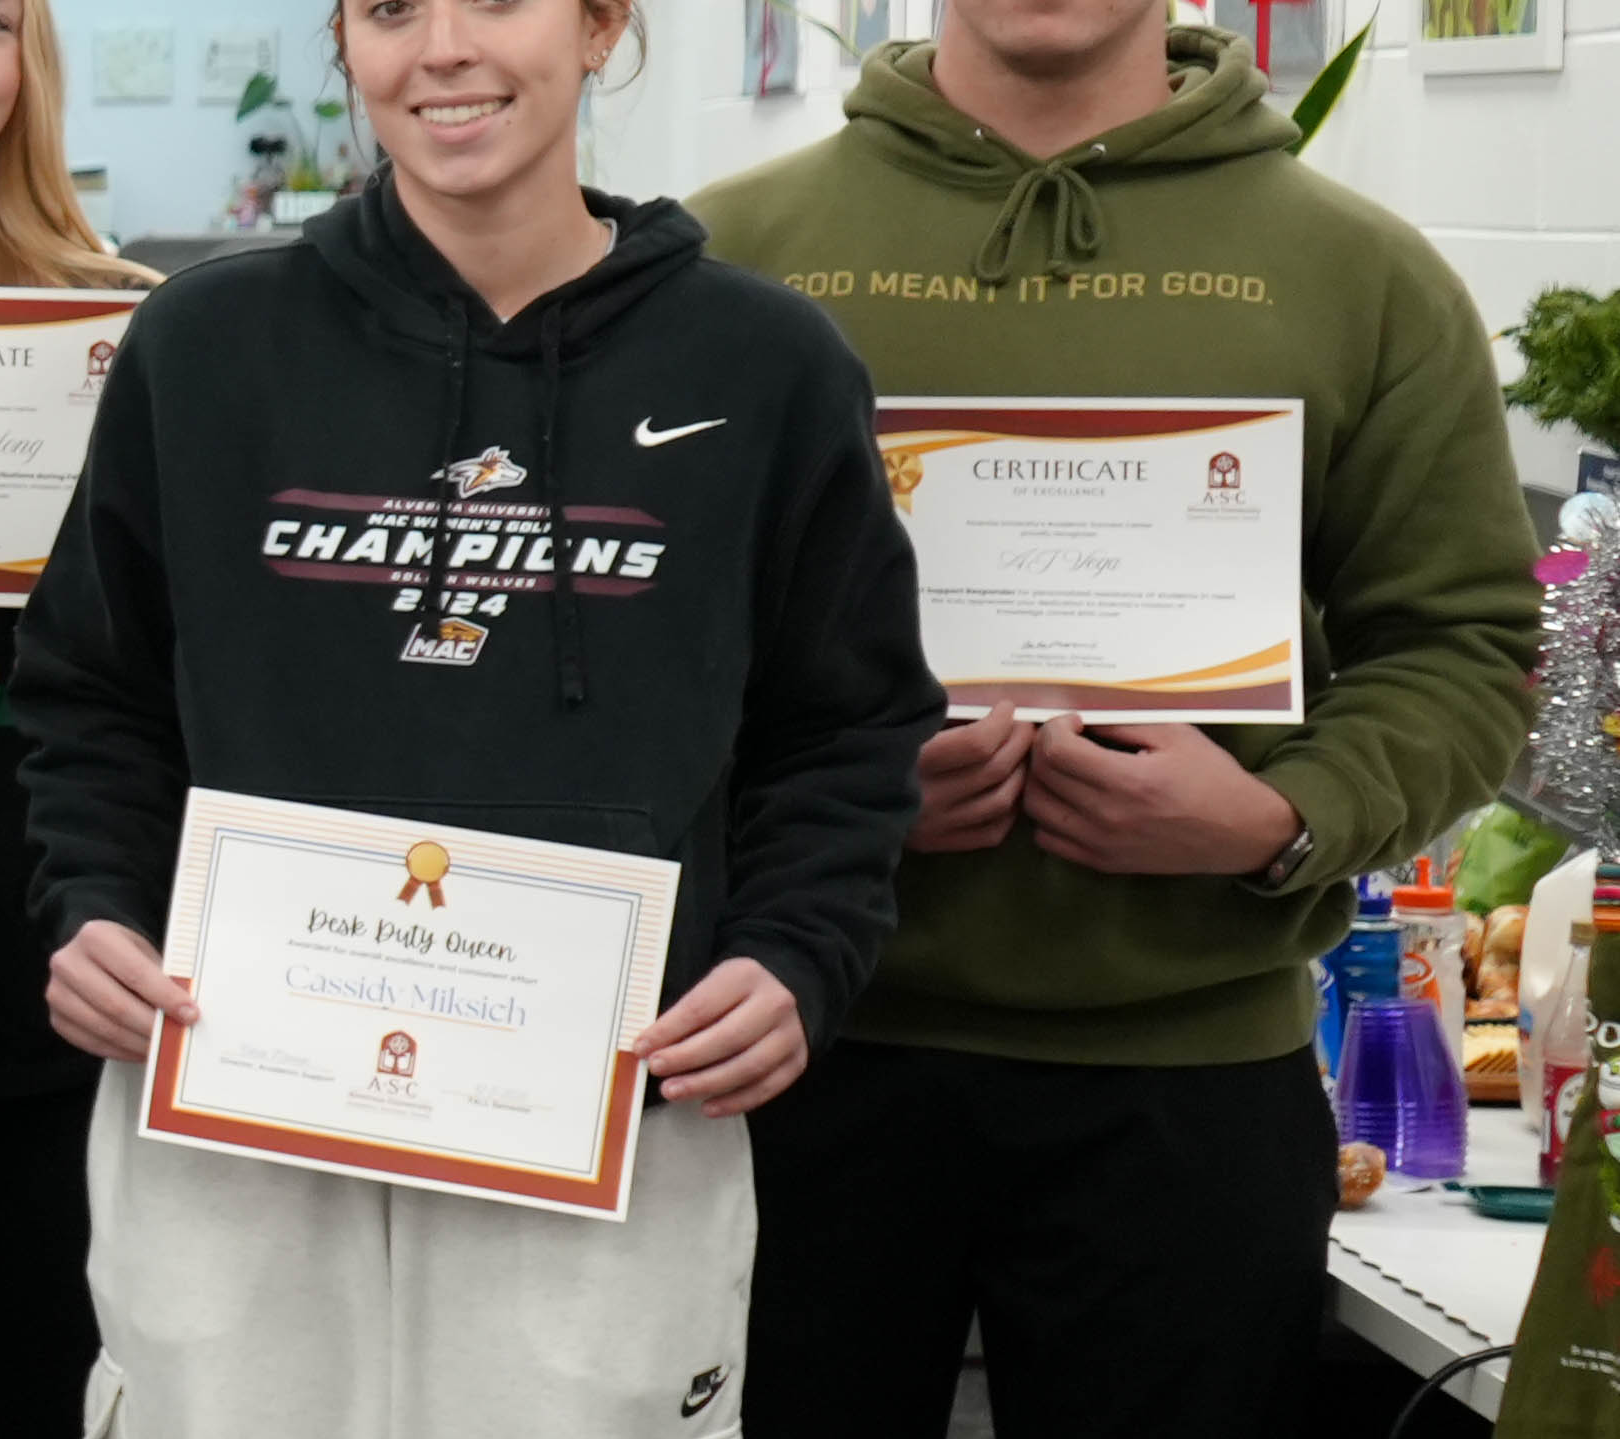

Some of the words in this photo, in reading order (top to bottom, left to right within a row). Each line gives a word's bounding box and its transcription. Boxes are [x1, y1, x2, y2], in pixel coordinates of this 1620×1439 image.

[784, 271, 855, 299] GOD
[1018, 275, 1052, 303] IT
[1069, 272, 1146, 300] FOR
[1161, 270, 1275, 305] GOOD.
[973, 459, 1148, 481] CERTIFICATE
[367, 513, 409, 527] MAC
[465, 576, 537, 589] WOLVES
[409, 638, 476, 660] MAC
[308, 908, 367, 937] Desk
[375, 919, 435, 954] Duty
[445, 931, 518, 962] Queen
[286, 964, 403, 1010] Cassidy
[412, 984, 526, 1026] Miksich
